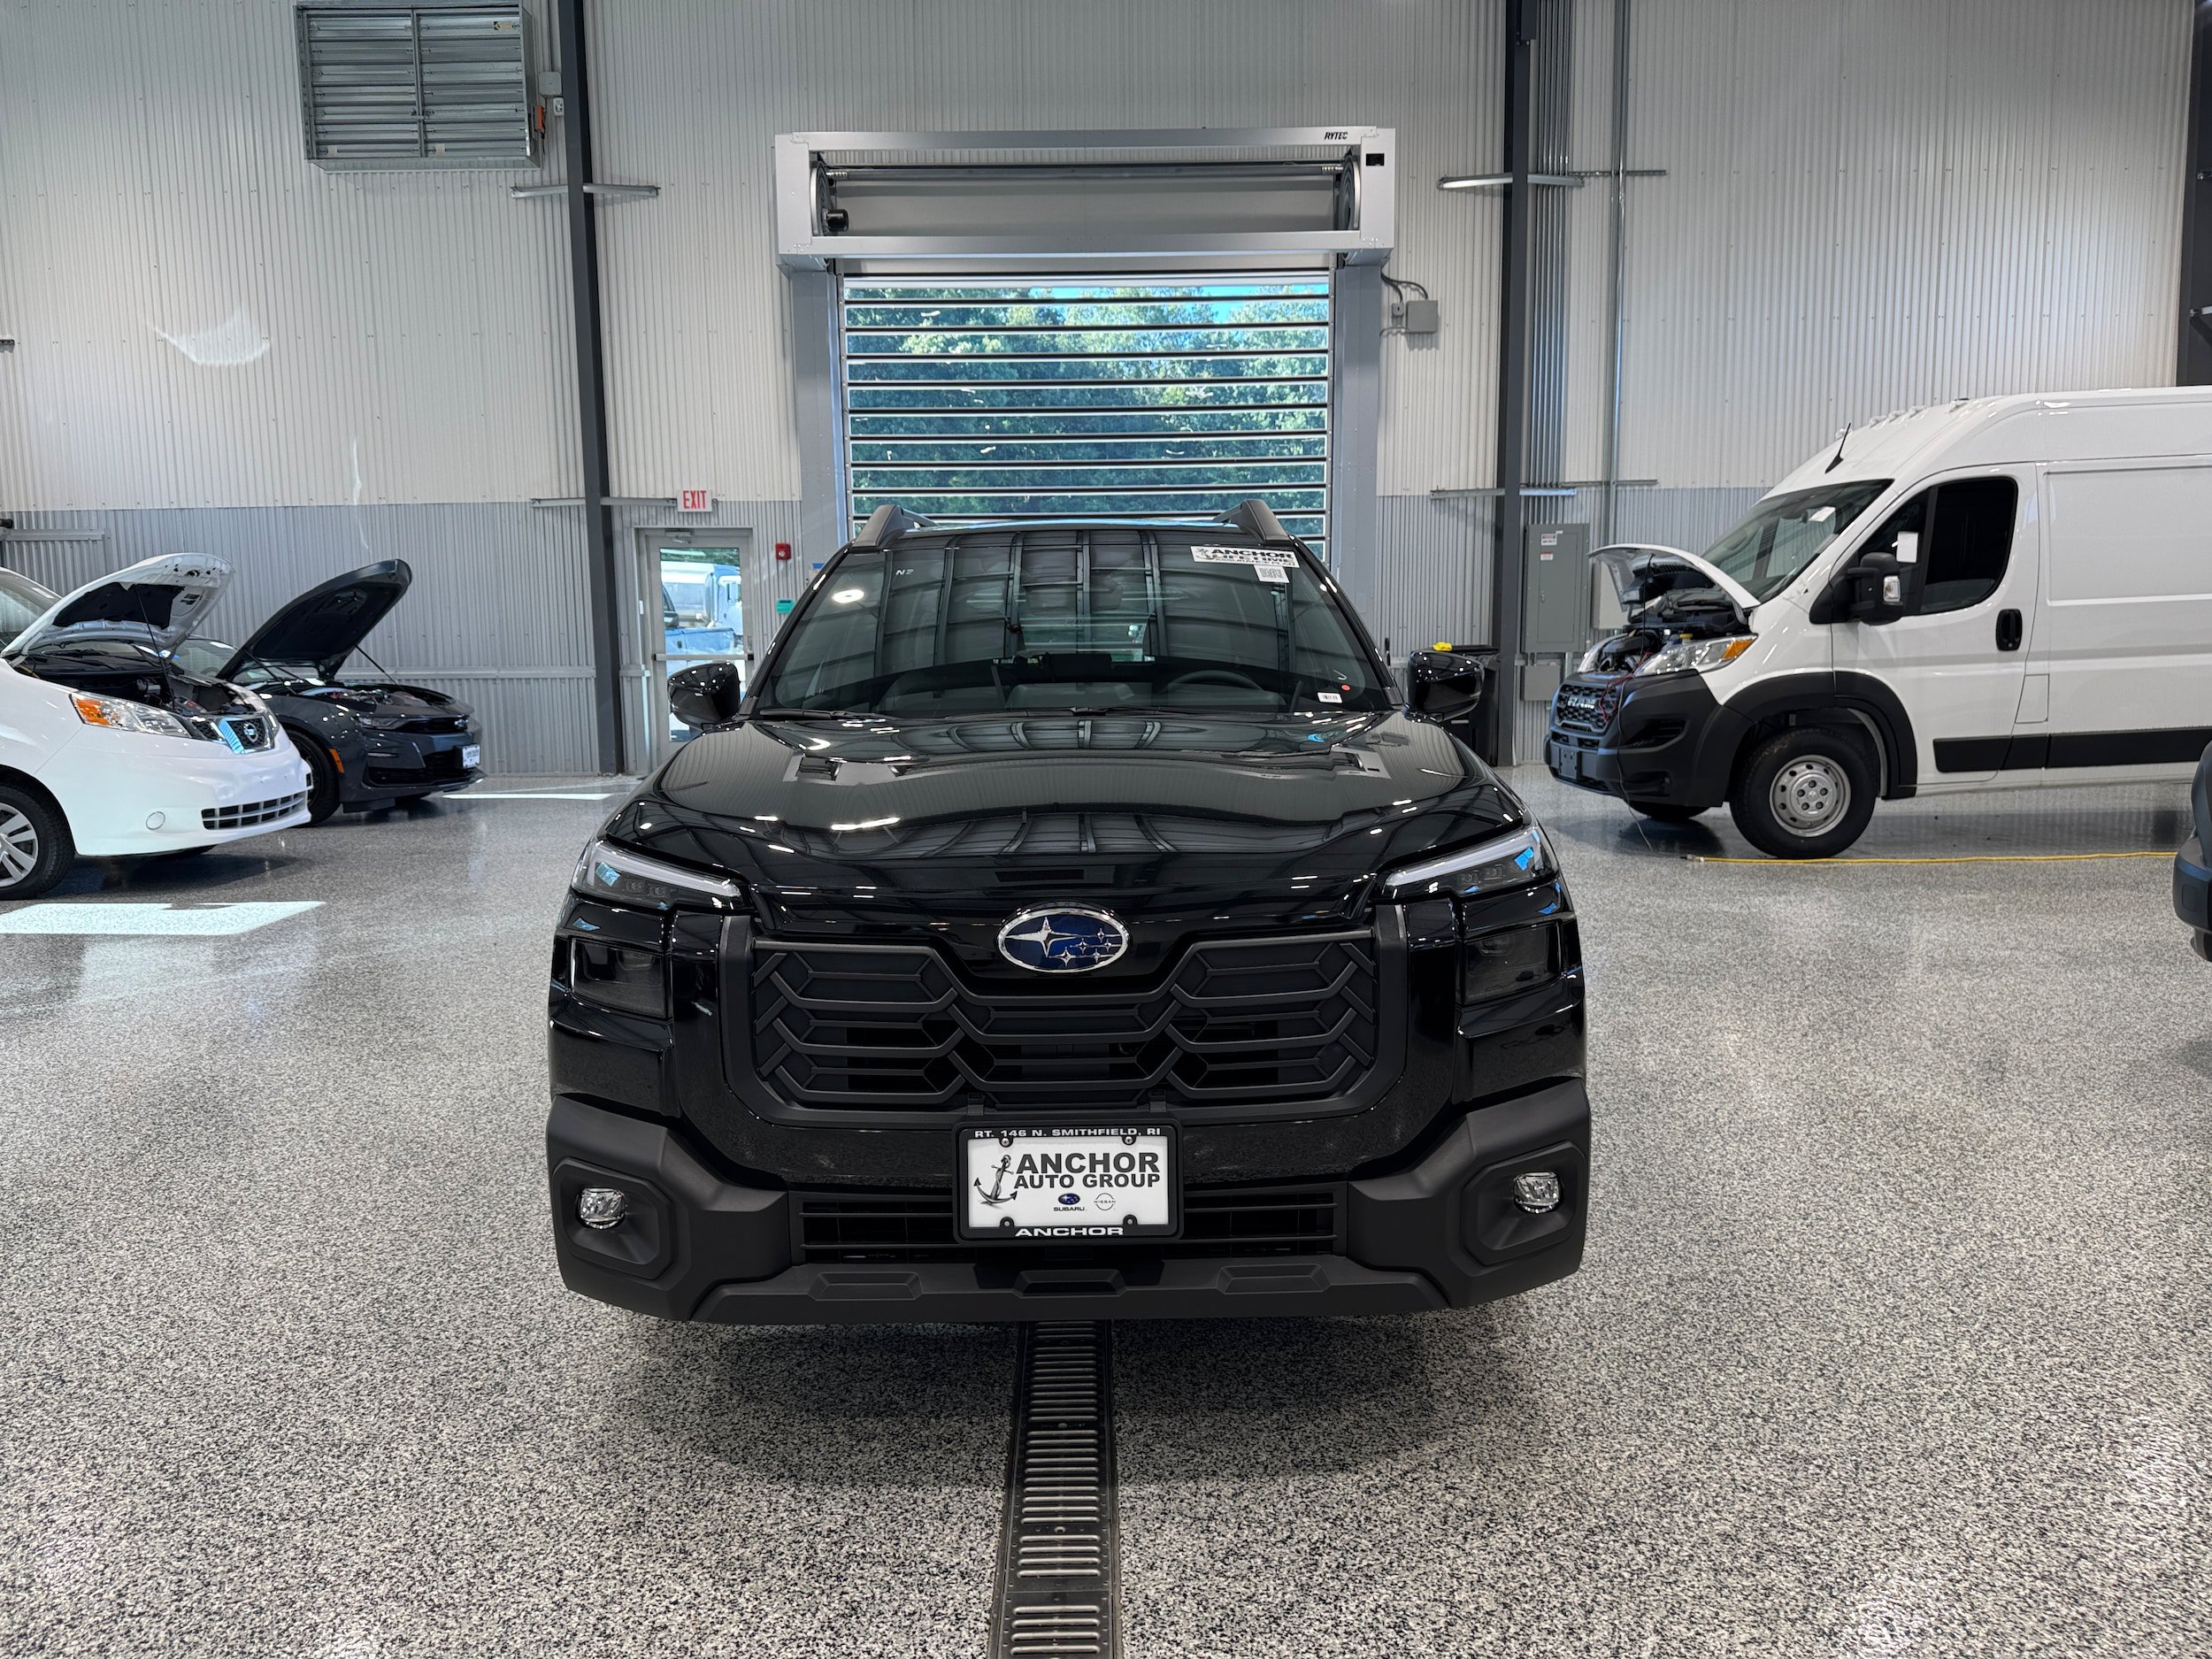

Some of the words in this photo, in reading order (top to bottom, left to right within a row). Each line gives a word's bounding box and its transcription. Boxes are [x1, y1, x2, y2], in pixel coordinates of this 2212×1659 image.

[683, 490, 706, 509] EXIT
[1211, 549, 1294, 558] ANCHOR
[1016, 1152, 1160, 1174] ANCHOR
[1014, 1174, 1074, 1189] AUTO
[1082, 1173, 1161, 1188] GROUP
[1015, 1226, 1124, 1237] ANCHOR
